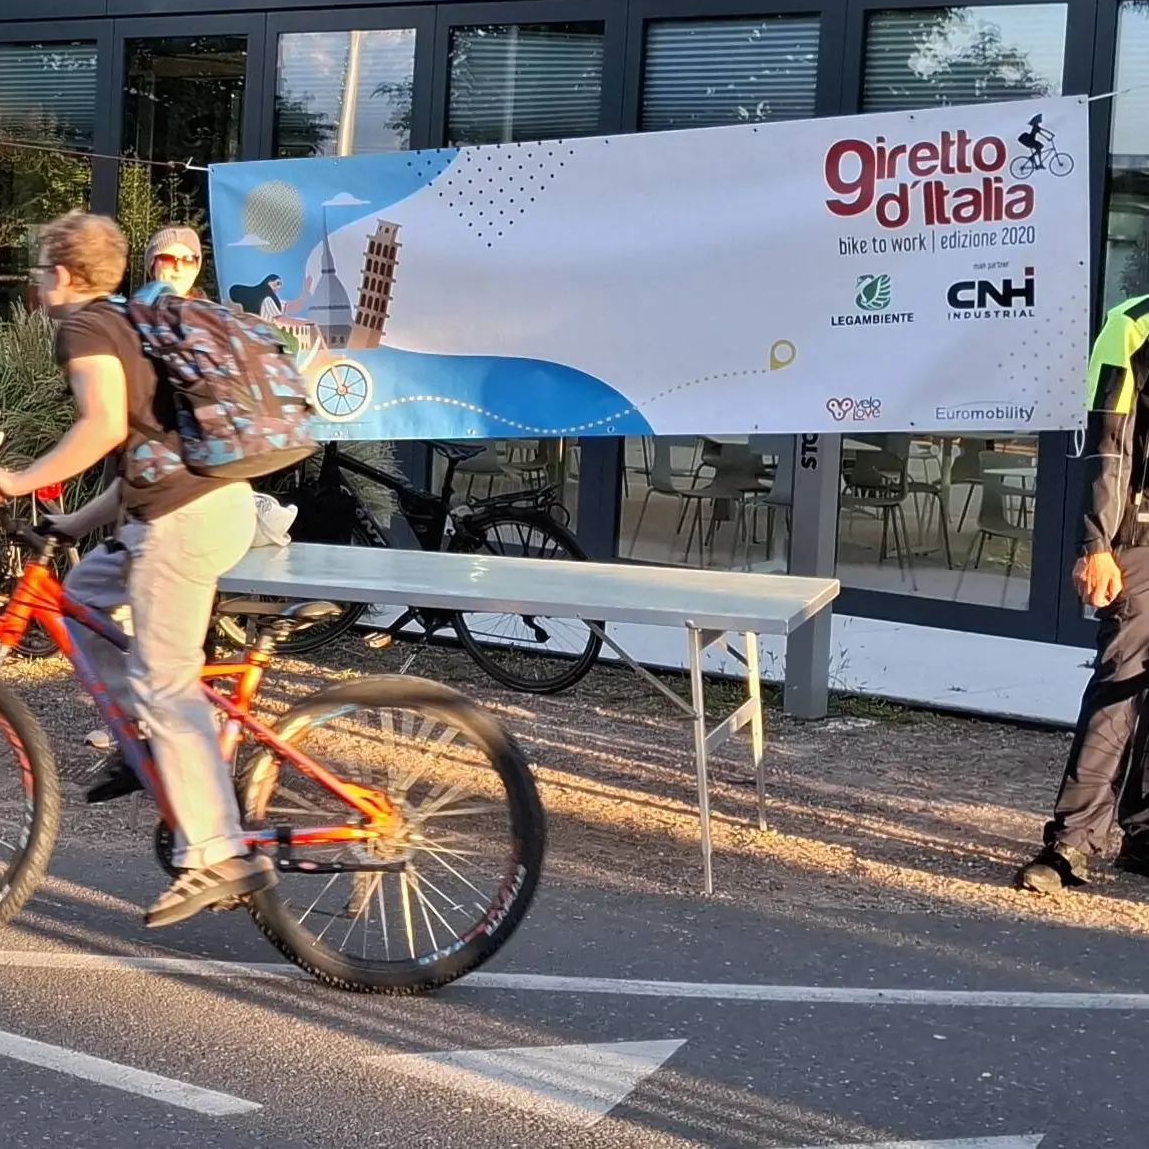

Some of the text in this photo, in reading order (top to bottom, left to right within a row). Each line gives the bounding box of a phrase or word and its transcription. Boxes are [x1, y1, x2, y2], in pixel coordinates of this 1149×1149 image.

[825, 129, 1007, 216] giretto
[839, 225, 1036, 255] bike to work edizione 2020
[946, 277, 1035, 309] CNH
[831, 312, 915, 326] LEGAMBIENTE
[947, 309, 1036, 320] INDUSTRIAL
[854, 396, 882, 409] velo
[935, 406, 1035, 423] Euromobility
